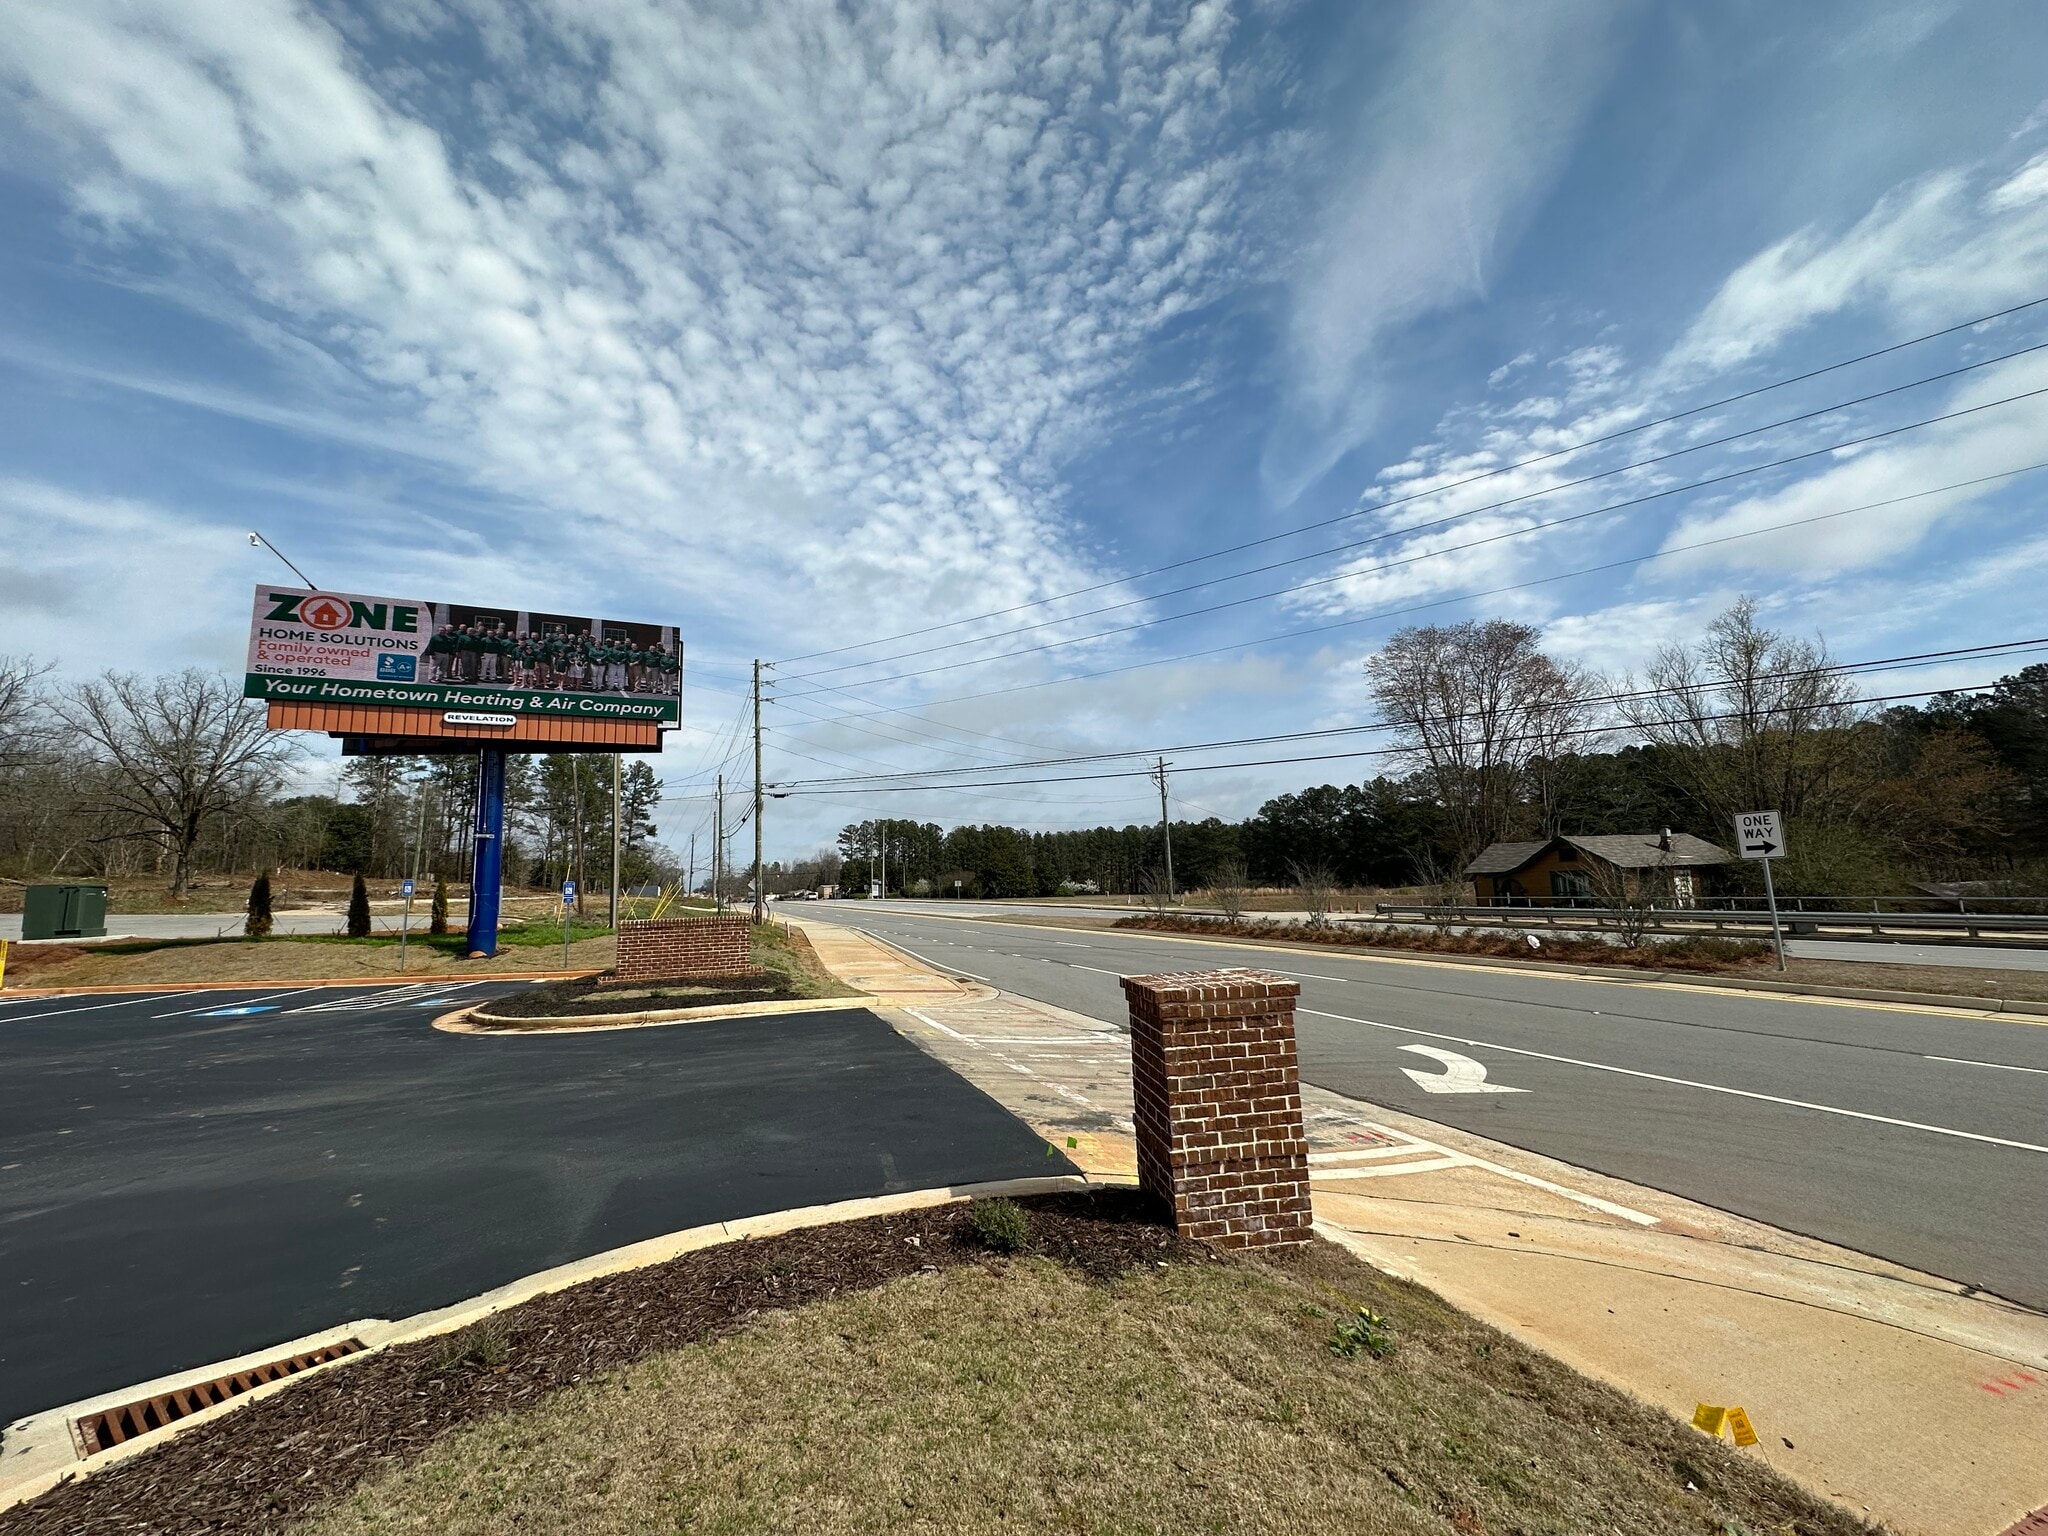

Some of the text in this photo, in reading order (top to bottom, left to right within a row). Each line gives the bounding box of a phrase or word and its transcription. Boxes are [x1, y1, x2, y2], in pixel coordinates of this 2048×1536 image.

[264, 593, 419, 633] ZONE
[260, 628, 418, 650] HOME SOLUTIONS
[257, 649, 352, 667] & operated
[258, 640, 370, 658] Family owned
[255, 664, 326, 677] Since 1996
[265, 679, 664, 717] Your Hometown Heating & Air Company
[447, 714, 514, 723] REVELATION
[1743, 815, 1772, 827] ONE
[1743, 827, 1773, 839] WAY
